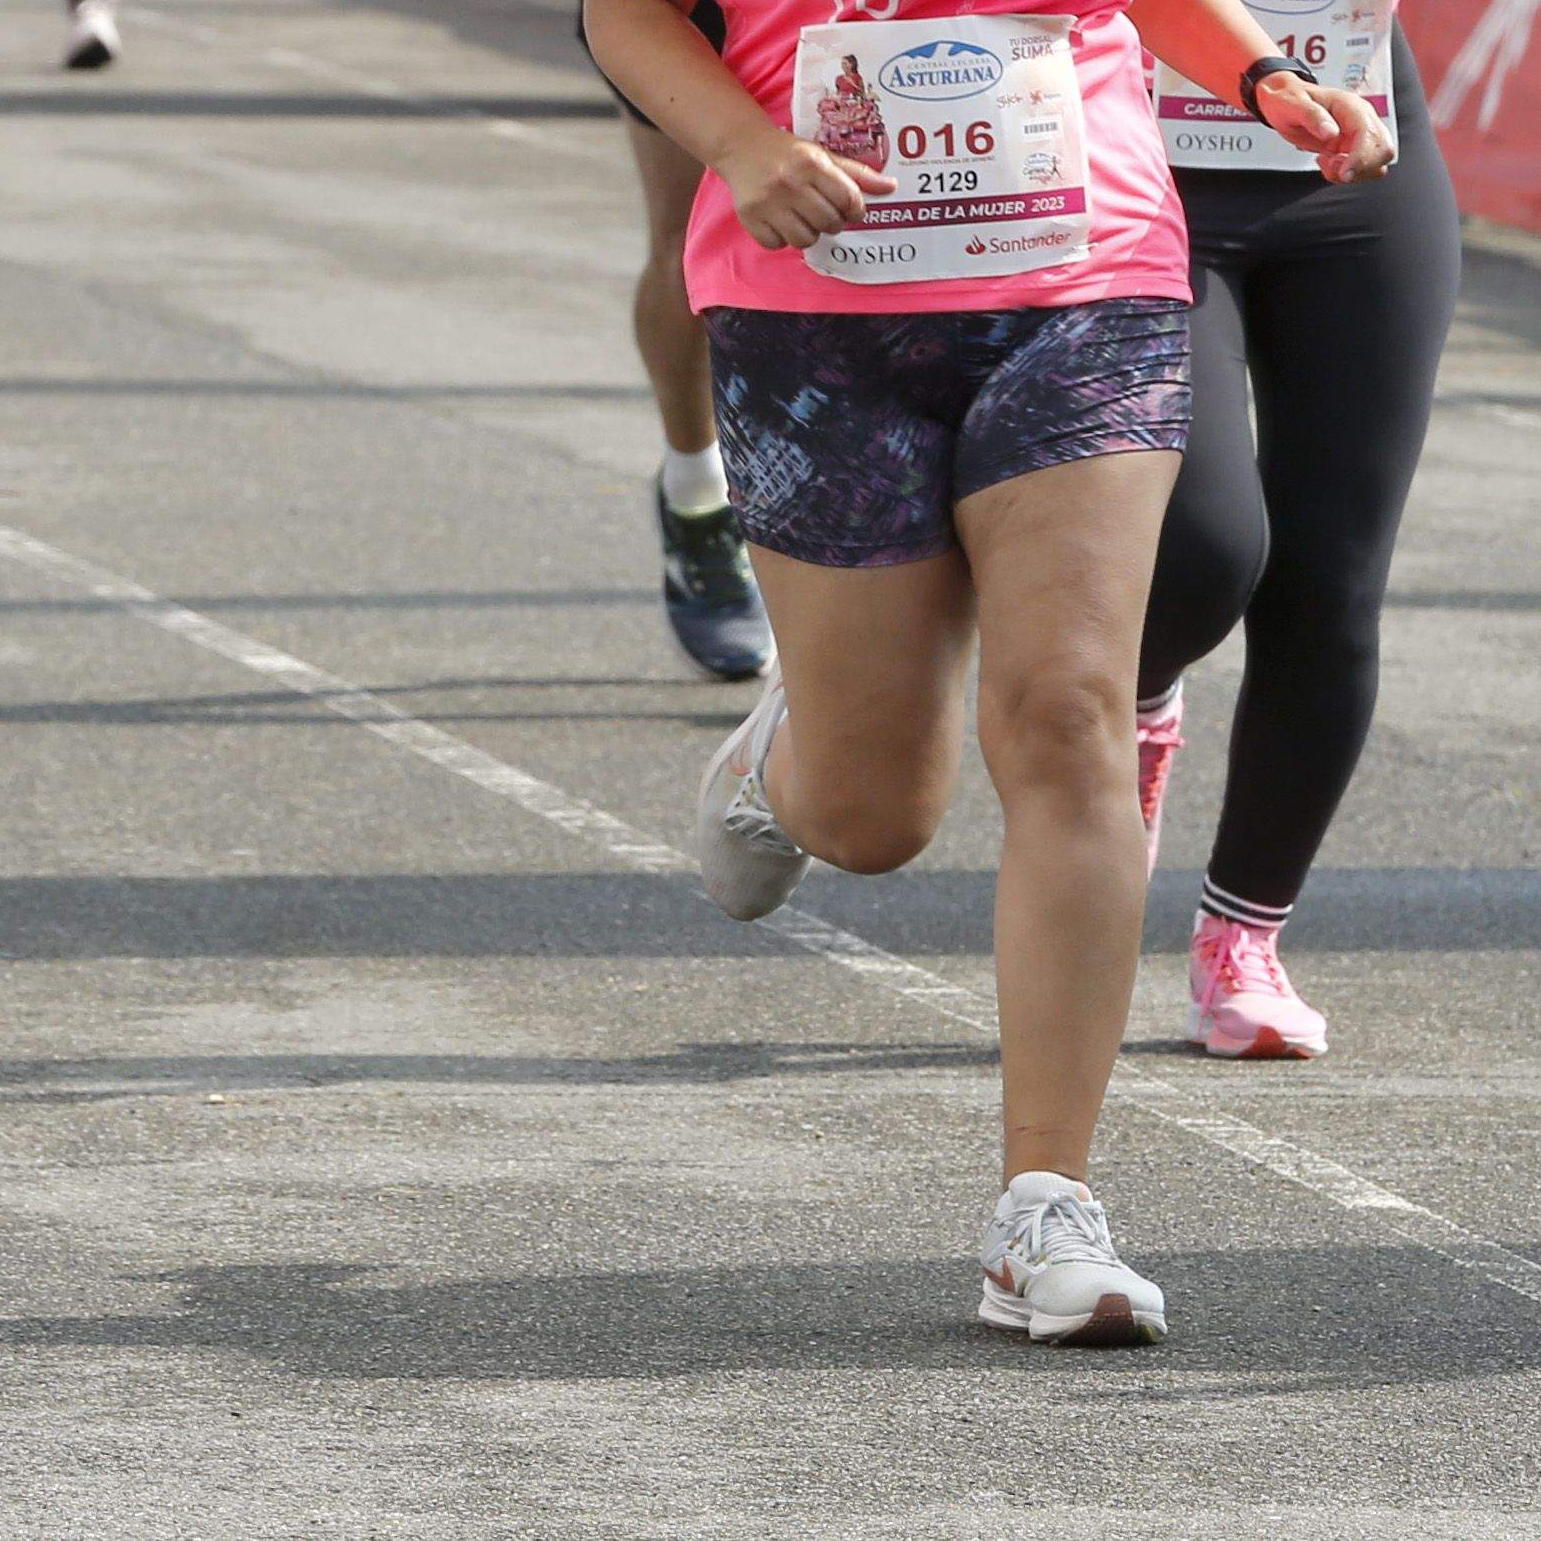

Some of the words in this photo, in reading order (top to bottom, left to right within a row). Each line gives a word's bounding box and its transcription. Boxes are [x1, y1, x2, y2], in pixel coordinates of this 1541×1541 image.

[1011, 43, 1054, 61] SUMA
[1277, 34, 1327, 64] 16
[890, 67, 996, 88] ASTURIANA
[897, 121, 995, 159] 016
[1176, 133, 1253, 152] OYSHO
[918, 170, 978, 194] 2129
[918, 209, 942, 222] DE
[944, 207, 967, 220] LA
[970, 201, 1026, 217] MUJER
[1031, 196, 1065, 212] 2023
[831, 243, 916, 265] OYSHO
[990, 231, 1071, 255] Santander
